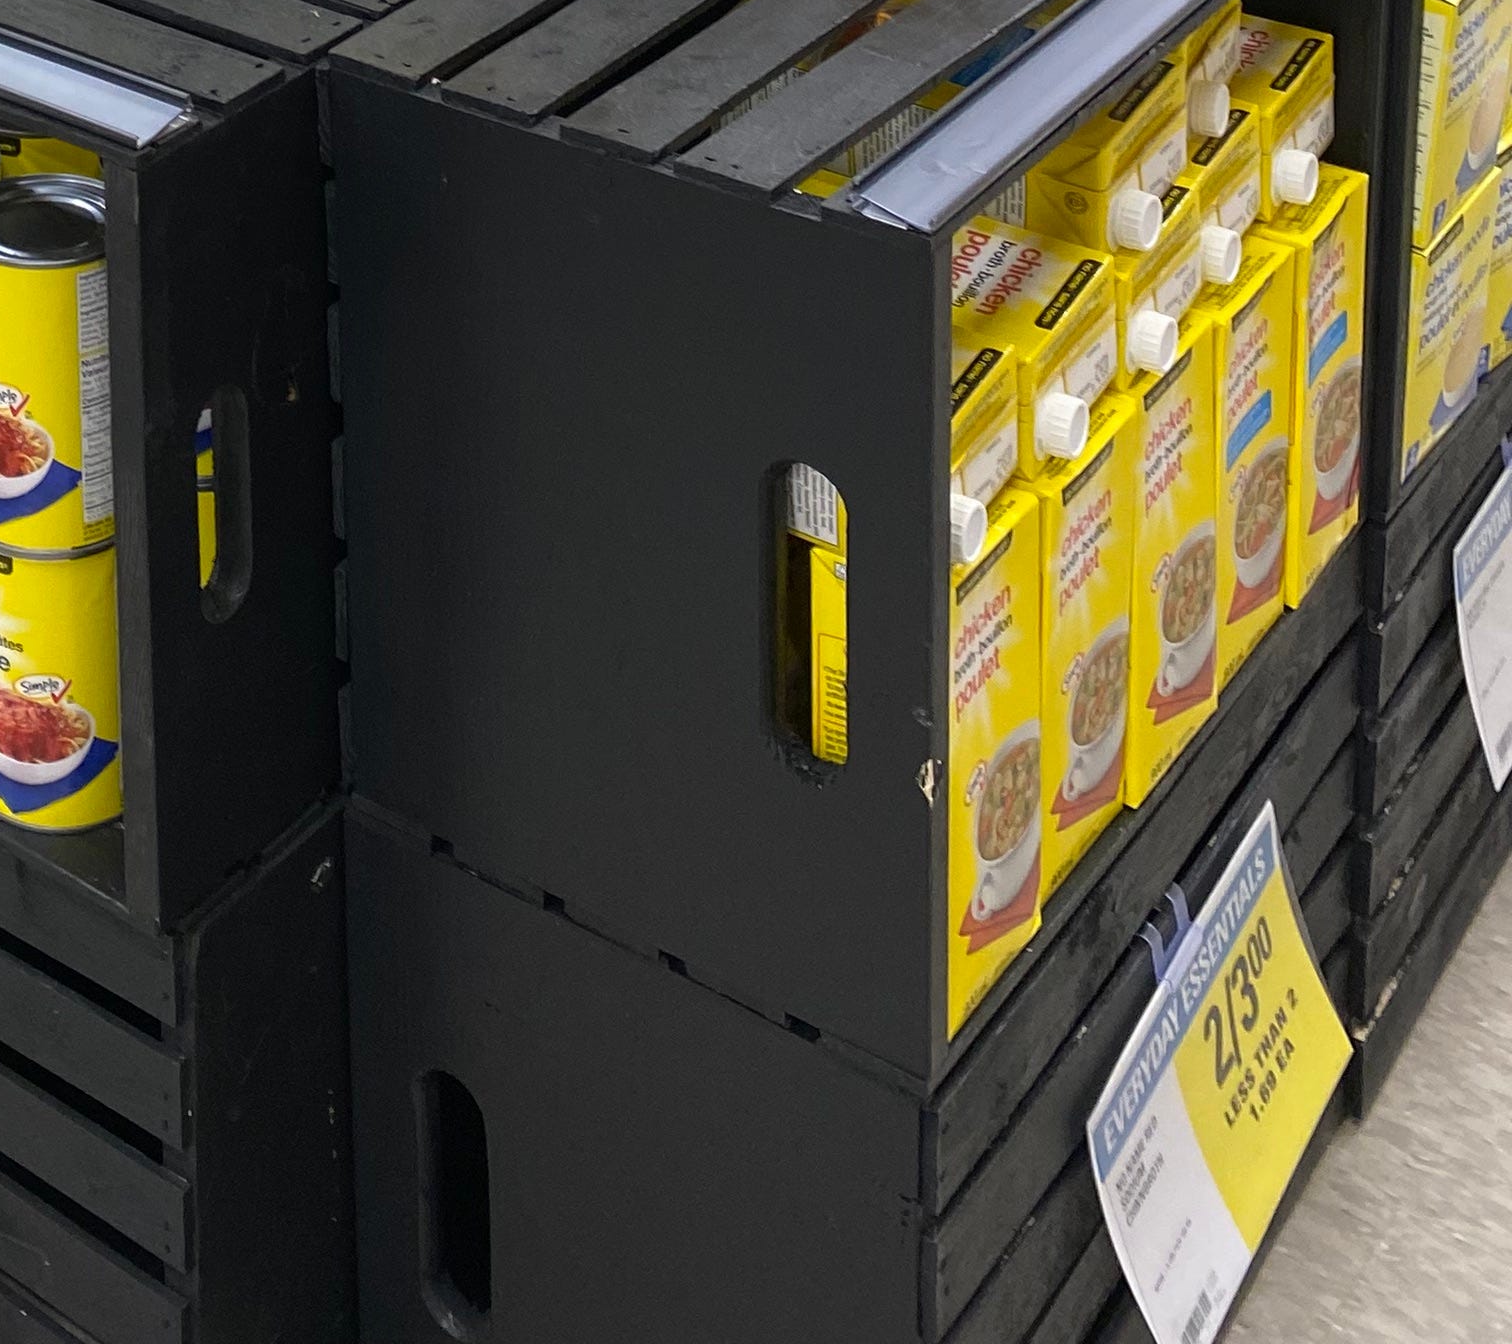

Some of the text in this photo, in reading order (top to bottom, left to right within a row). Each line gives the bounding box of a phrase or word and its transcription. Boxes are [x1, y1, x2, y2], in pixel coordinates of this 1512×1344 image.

[1103, 992, 1183, 1156] EVERYDAY
[1182, 846, 1267, 1014] ESSENTIALS
[1223, 987, 1299, 1130] LESS THAN 2
[1275, 1042, 1297, 1073] EA
